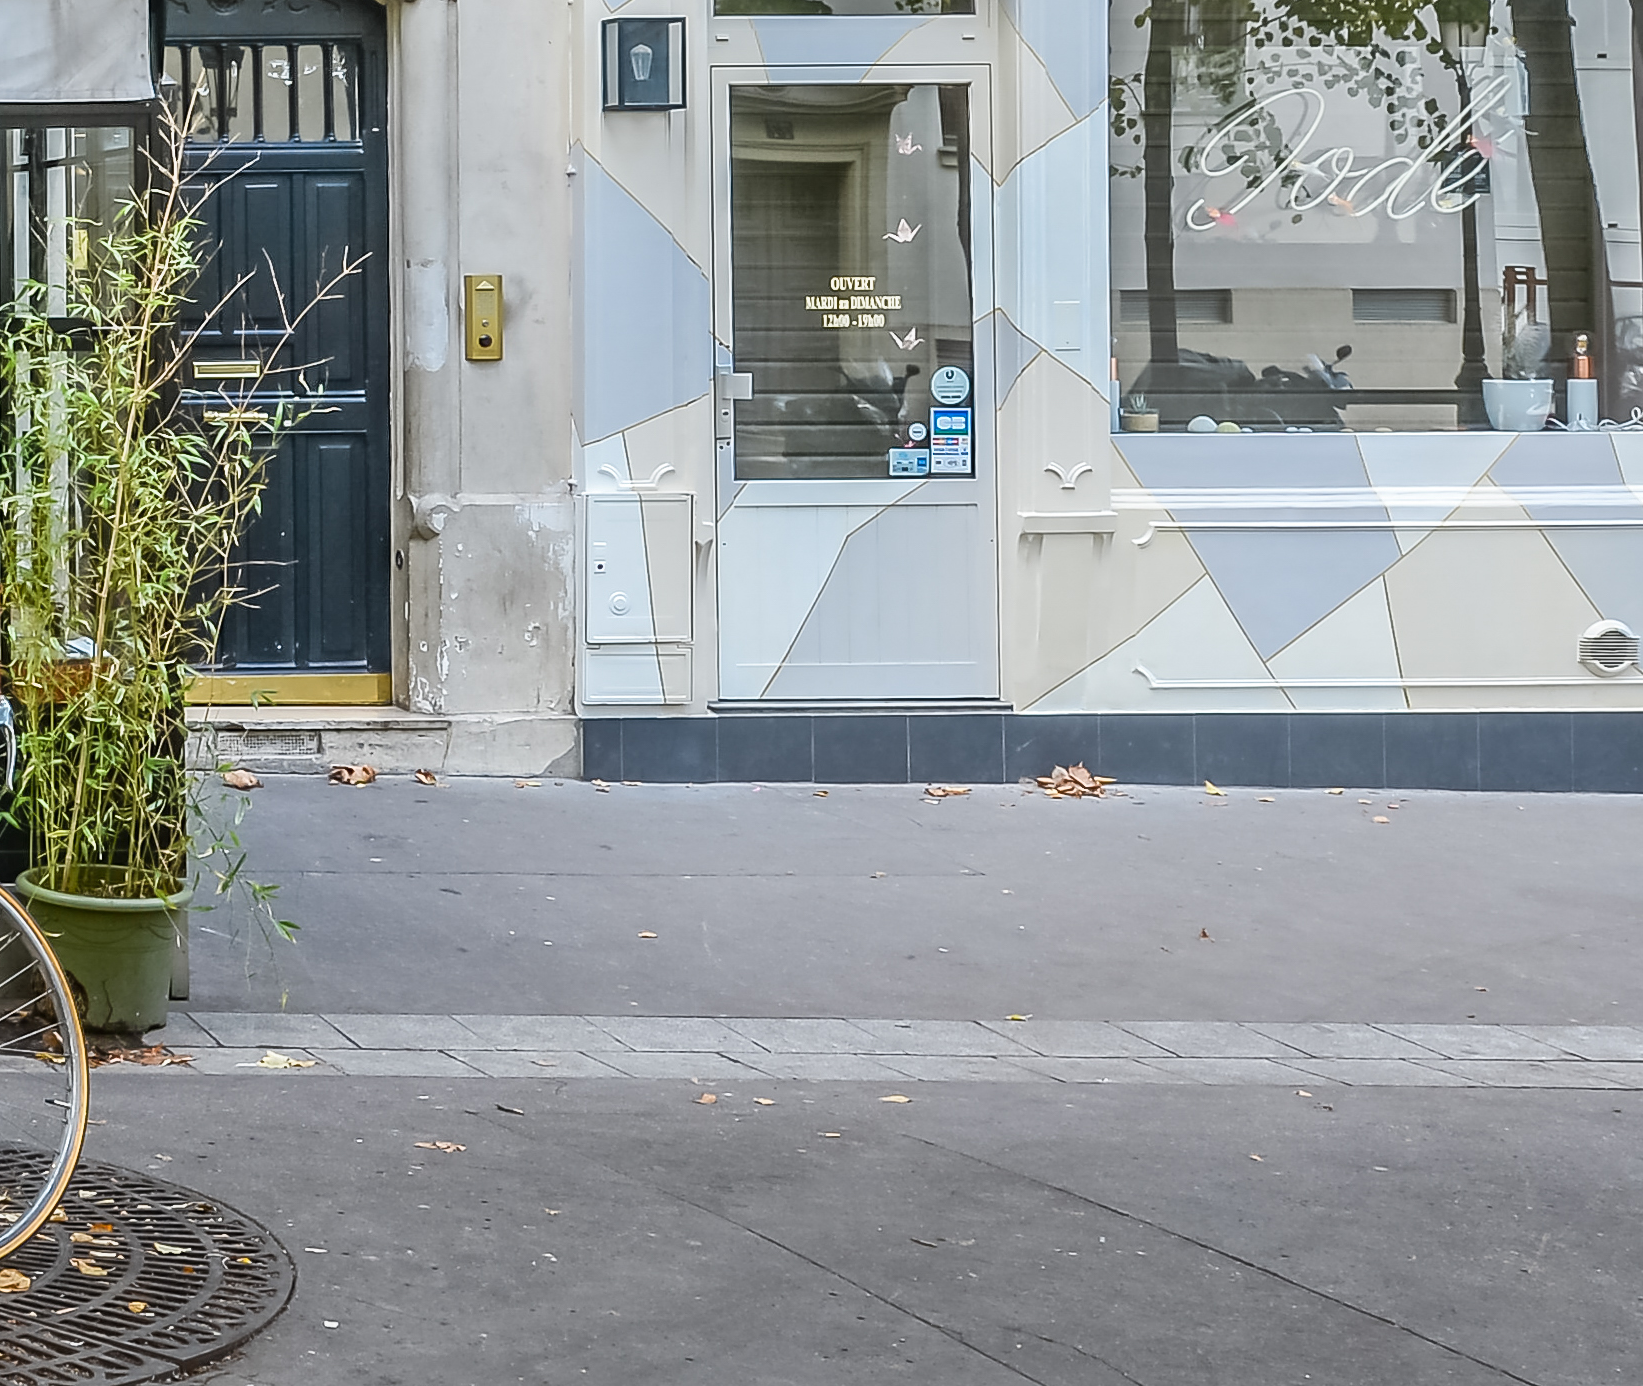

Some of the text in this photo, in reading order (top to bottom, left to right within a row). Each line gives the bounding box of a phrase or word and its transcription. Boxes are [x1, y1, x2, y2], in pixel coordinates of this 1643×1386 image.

[830, 276, 876, 291] OUVERT
[805, 295, 838, 310] MARDI
[850, 295, 902, 310] DIMANCHE
